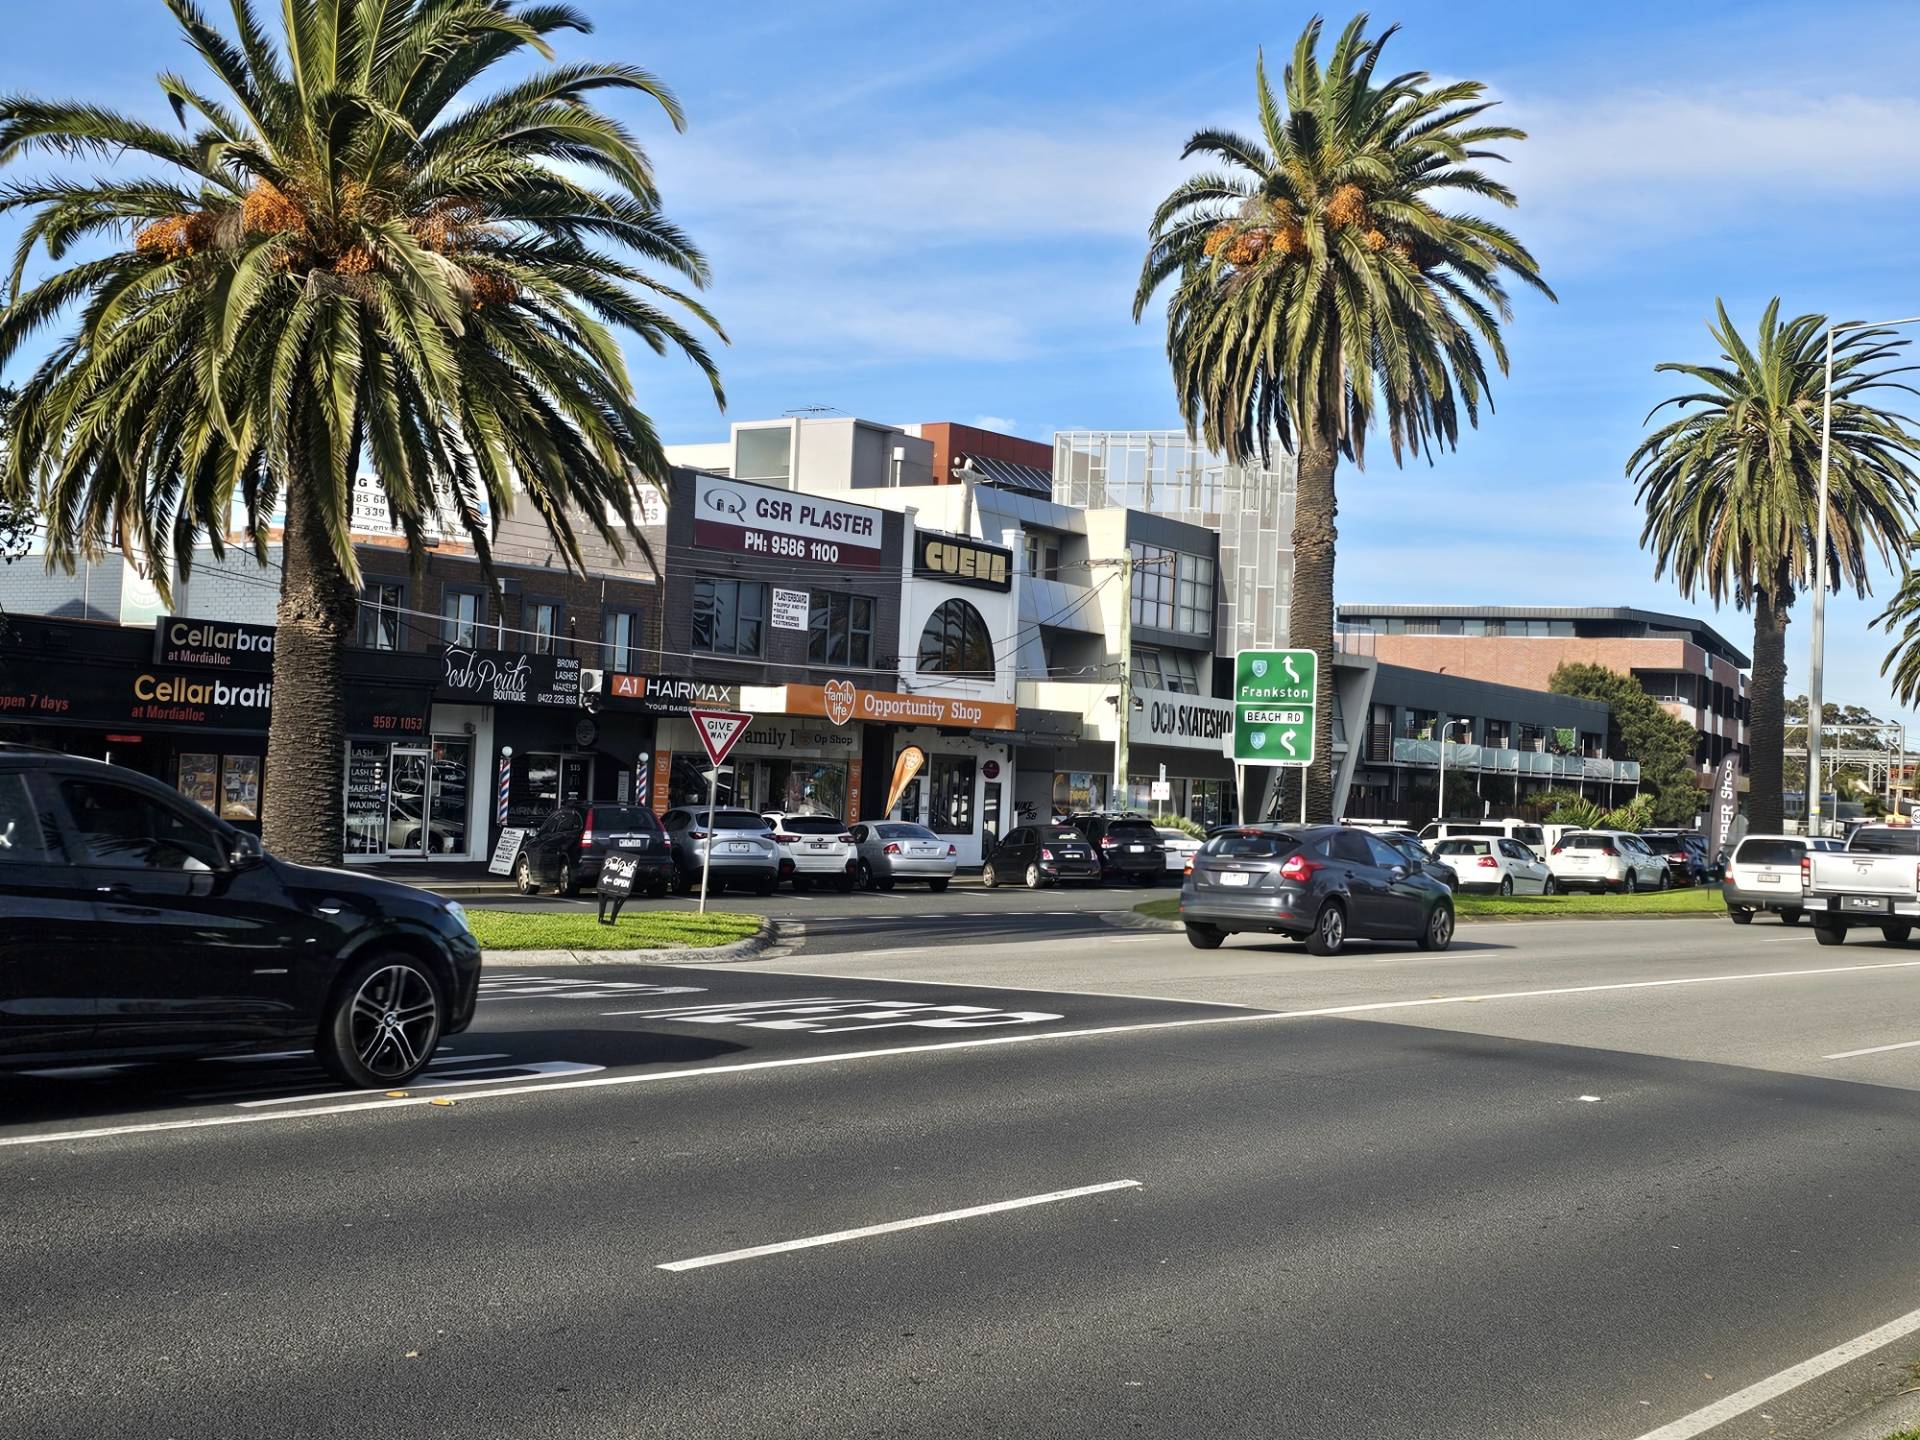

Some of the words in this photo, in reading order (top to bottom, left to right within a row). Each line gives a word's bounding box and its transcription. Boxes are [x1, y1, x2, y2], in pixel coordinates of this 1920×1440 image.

[756, 498, 793, 522] GSR
[799, 505, 873, 536] PLASTER
[745, 531, 767, 552] PH:
[771, 535, 805, 557] 9586
[810, 542, 839, 563] 1100
[170, 623, 275, 653] Cellarbra
[168, 650, 178, 661] at
[180, 650, 231, 665] Mordialloc
[557, 658, 579, 669] BROWS
[477, 654, 532, 692] Pouts
[555, 670, 578, 681] LASHES
[134, 674, 271, 708] Cellarbrati
[552, 683, 578, 693] MAKEUP
[619, 677, 638, 695] A1
[646, 679, 731, 702] HAIRMAX
[1241, 686, 1308, 699] Frankston
[0, 696, 26, 711] open
[30, 693, 38, 708] 7
[41, 695, 69, 712] days
[493, 690, 527, 702] BOUTIQUE
[537, 693, 553, 703] 0422
[554, 694, 565, 704] 225
[827, 687, 854, 706] family
[131, 707, 143, 718] at
[147, 706, 205, 722] Mordialloc
[864, 693, 946, 721] Opportunity
[951, 702, 982, 724] Shop
[373, 715, 398, 729] 9587
[400, 717, 423, 731] 1053
[1151, 700, 1176, 734] OCD
[1178, 704, 1234, 740] SKATESHO
[1247, 712, 1282, 722] BEACH
[1287, 713, 1301, 723] RD
[708, 720, 733, 732] GIVE
[710, 731, 728, 740] WAY
[738, 728, 786, 749] amily
[814, 734, 828, 745] Op
[830, 733, 853, 746] Shop
[351, 748, 374, 758] LASH
[351, 768, 369, 776] LASH
[1720, 759, 1733, 800] SHOP
[348, 801, 380, 809] WAXING
[509, 806, 552, 816] AIRMAX
[613, 878, 631, 889] OPEN
[600, 996, 1066, 1034] KEEP
